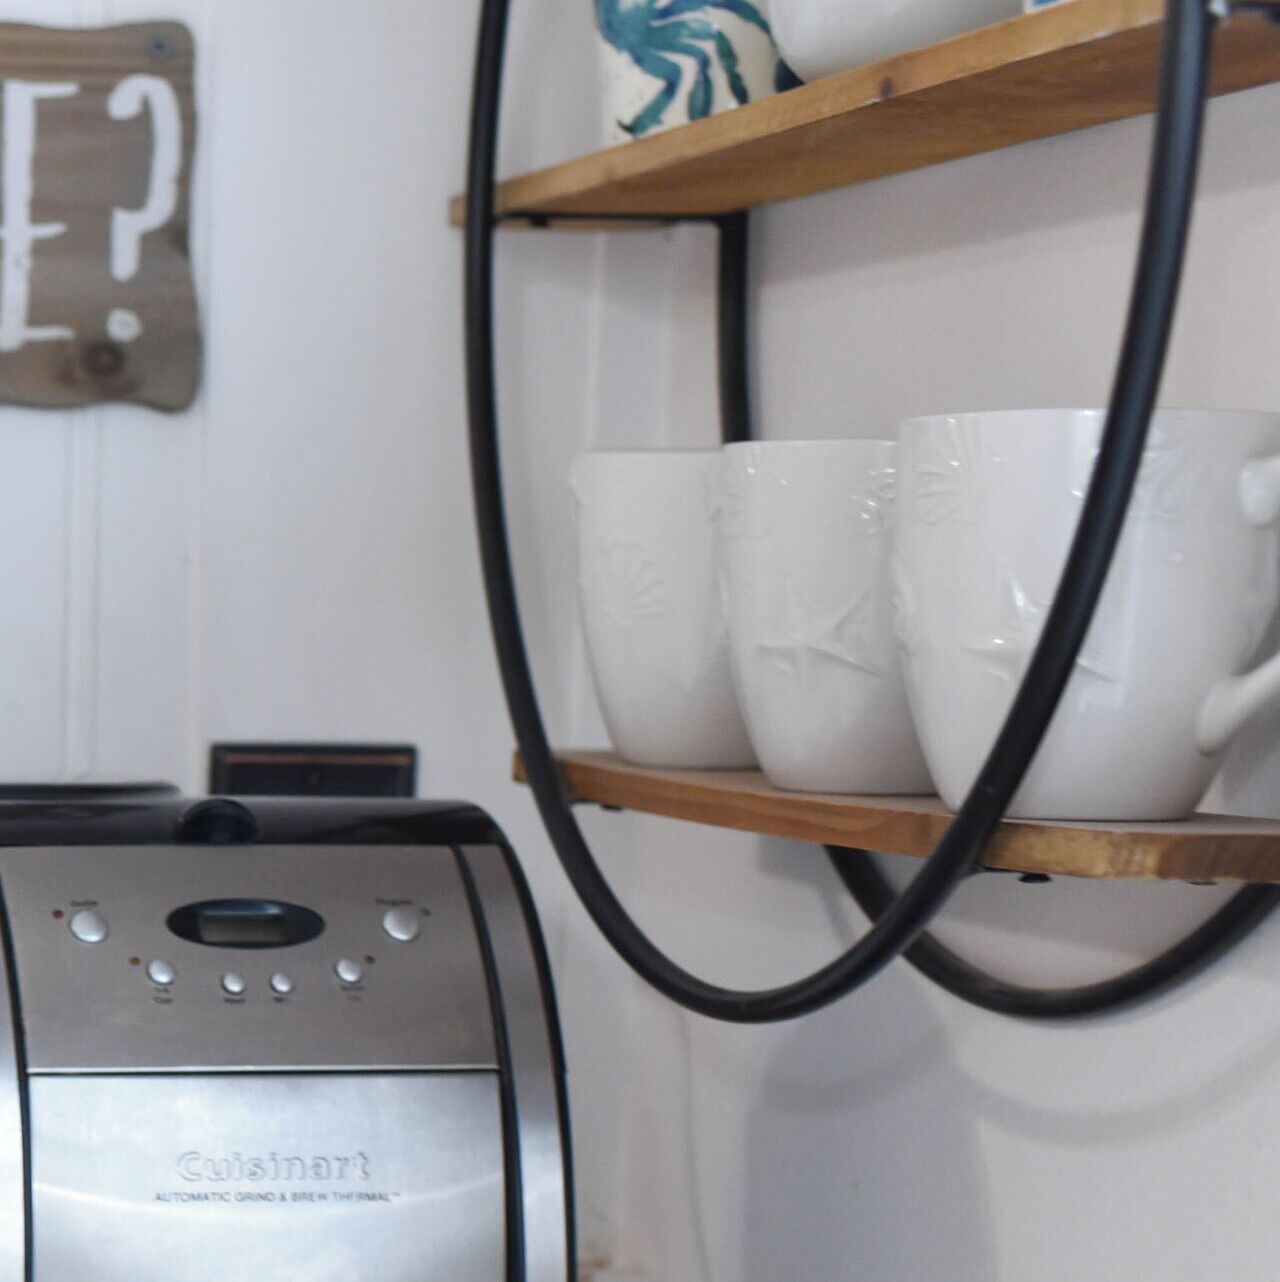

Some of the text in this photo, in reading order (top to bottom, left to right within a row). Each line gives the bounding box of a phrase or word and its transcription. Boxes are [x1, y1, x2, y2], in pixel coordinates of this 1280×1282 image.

[177, 1151, 370, 1182] Cuisinart
[154, 1191, 232, 1203] AUTOMATIC
[234, 1191, 276, 1202] GRIND
[291, 1191, 328, 1202] BREW
